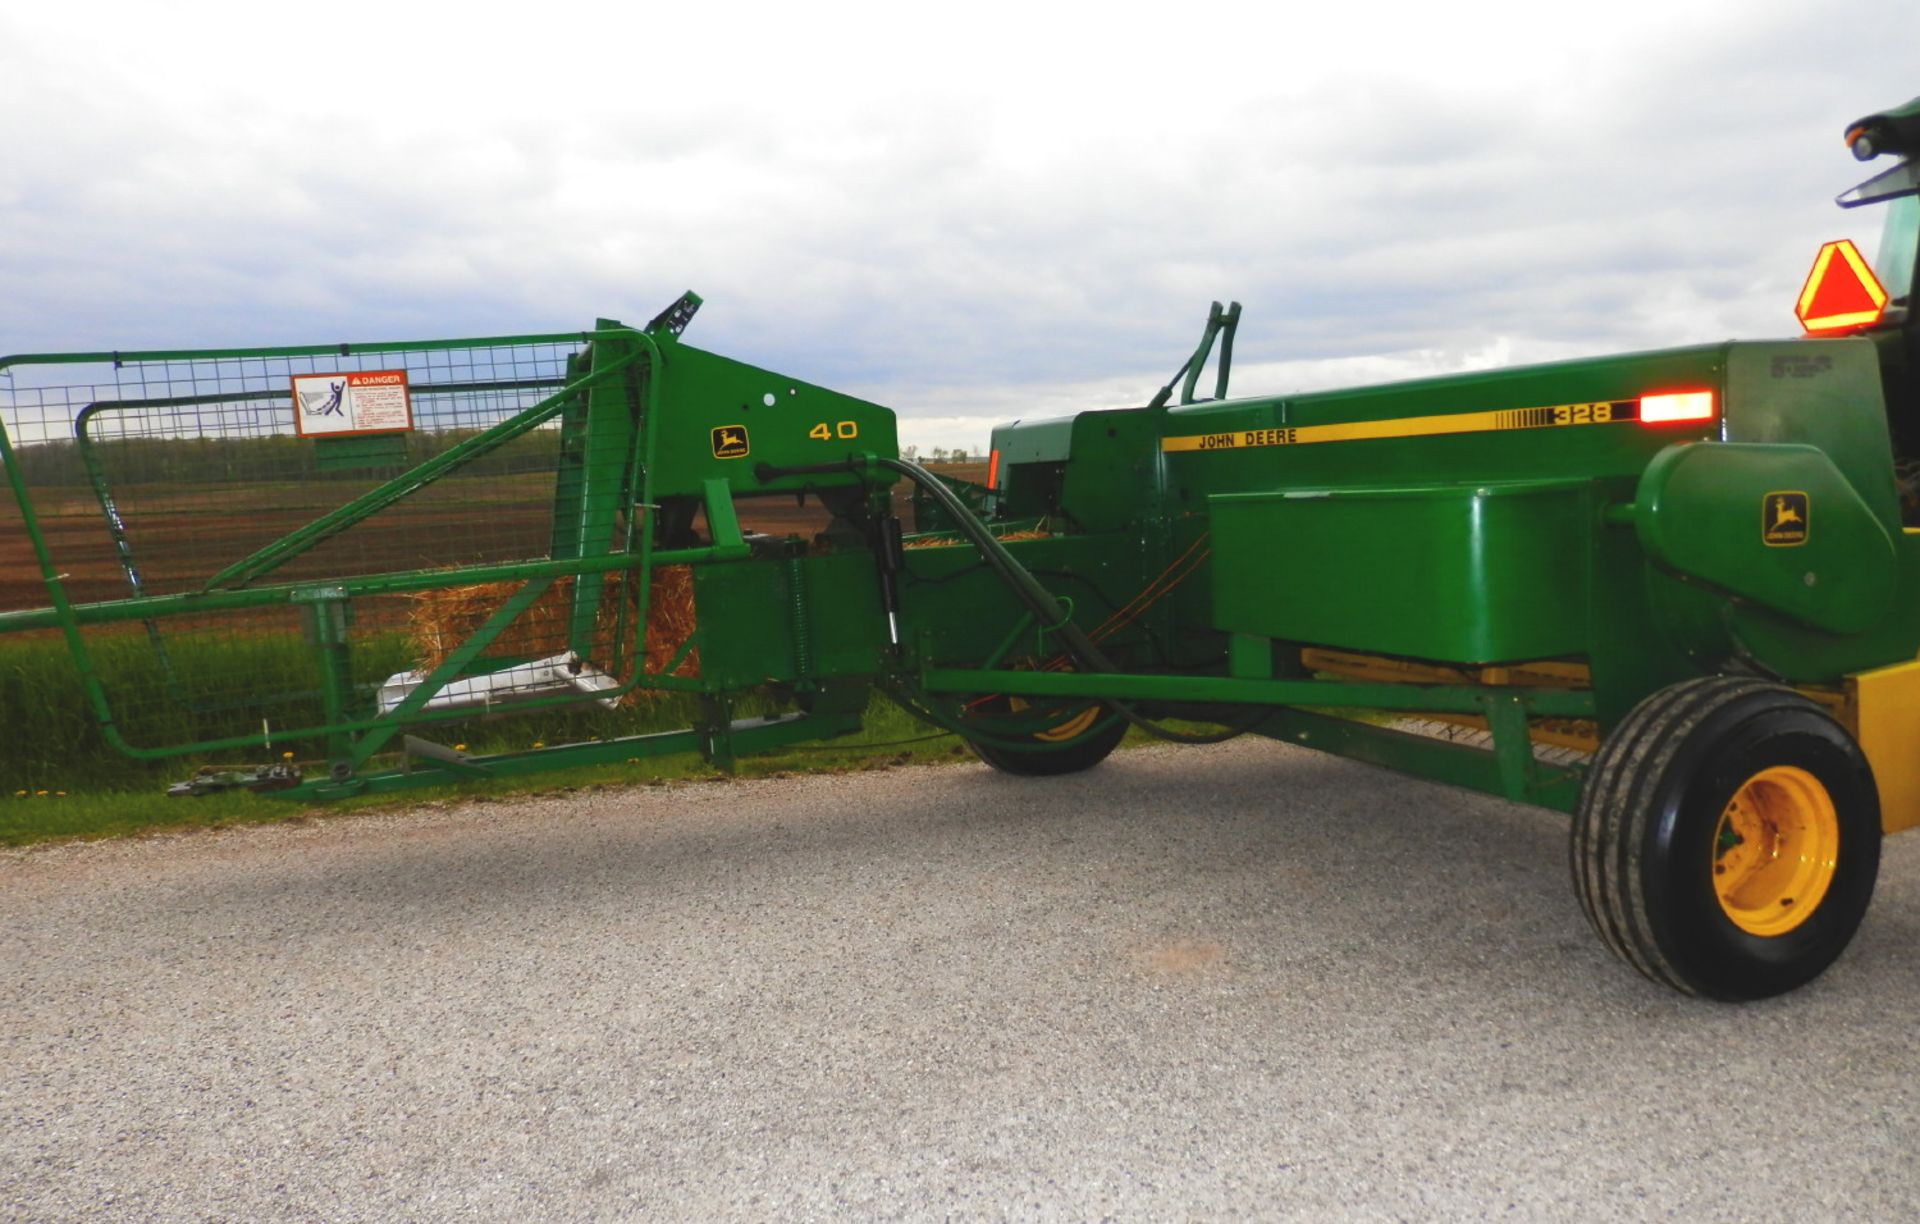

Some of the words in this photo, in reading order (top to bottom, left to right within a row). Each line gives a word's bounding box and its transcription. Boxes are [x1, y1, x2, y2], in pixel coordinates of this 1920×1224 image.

[362, 375, 400, 385] DANGER
[1553, 402, 1611, 425] 328
[809, 421, 858, 440] 40
[1199, 434, 1234, 448] JOHN
[1245, 429, 1297, 445] DEERE
